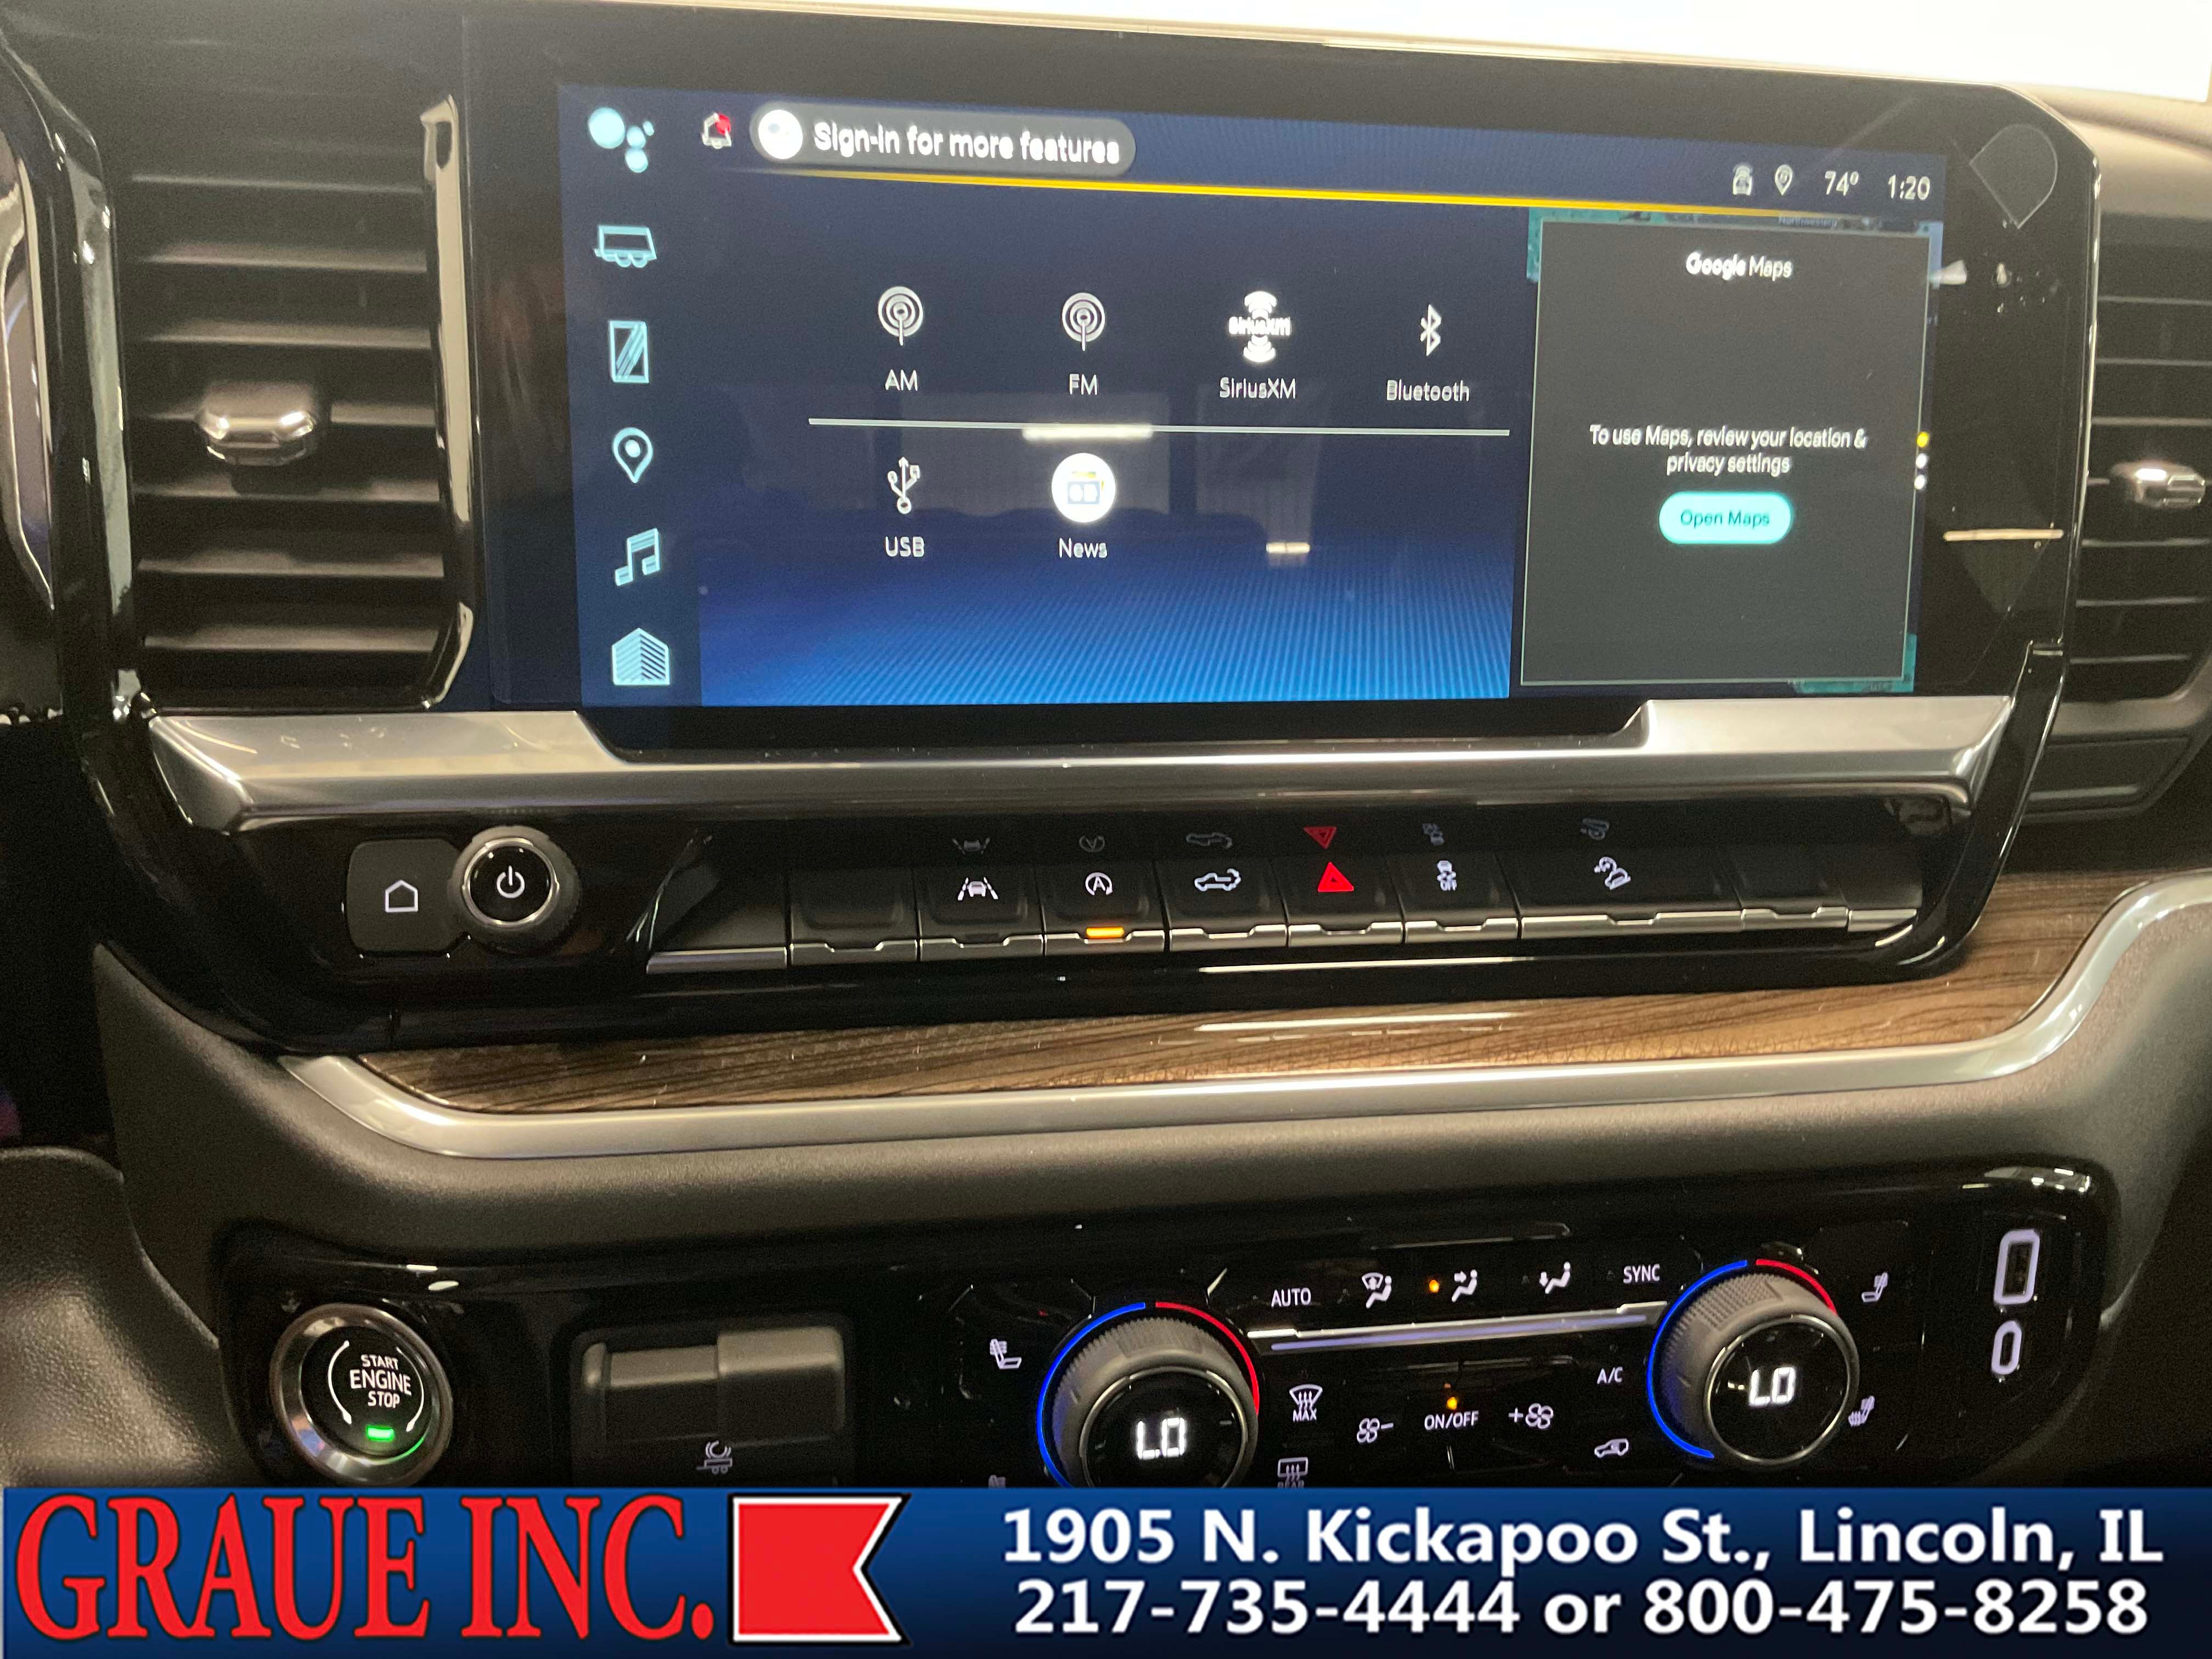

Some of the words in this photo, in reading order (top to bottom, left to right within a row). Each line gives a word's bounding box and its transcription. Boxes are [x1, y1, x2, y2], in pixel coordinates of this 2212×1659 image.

[813, 121, 900, 157] Sign-in
[906, 123, 945, 156] for
[950, 131, 1013, 159] more
[1019, 128, 1120, 164] features
[1888, 174, 1931, 201] 1:20
[1685, 250, 1746, 281] Google
[1748, 255, 1793, 281] Maps
[884, 369, 918, 391] AM
[1069, 373, 1098, 395] FM
[1219, 377, 1296, 399] SiriusXM
[1386, 379, 1470, 402] Bluetooth
[1589, 424, 1609, 445] To
[1612, 428, 1642, 445] use
[1645, 425, 1693, 449] Maps,
[1697, 426, 1748, 447] review
[1750, 430, 1787, 450] your
[1789, 427, 1850, 448] location
[1853, 428, 1869, 449] &
[1666, 452, 1725, 476] privacy
[1727, 452, 1792, 477] settings
[1680, 509, 1723, 528] Open
[1728, 510, 1770, 528] Maps
[885, 536, 925, 558] USB
[1058, 537, 1108, 558] News
[1623, 1263, 1660, 1284] SYNC
[1271, 1288, 1311, 1307] AUTO
[360, 1354, 398, 1370] START
[349, 1369, 411, 1396] ENGINE
[1597, 1367, 1623, 1384] A/C
[368, 1391, 400, 1408] STOP
[1293, 1409, 1317, 1422] MAX
[1424, 1410, 1479, 1430] ON/OFF
